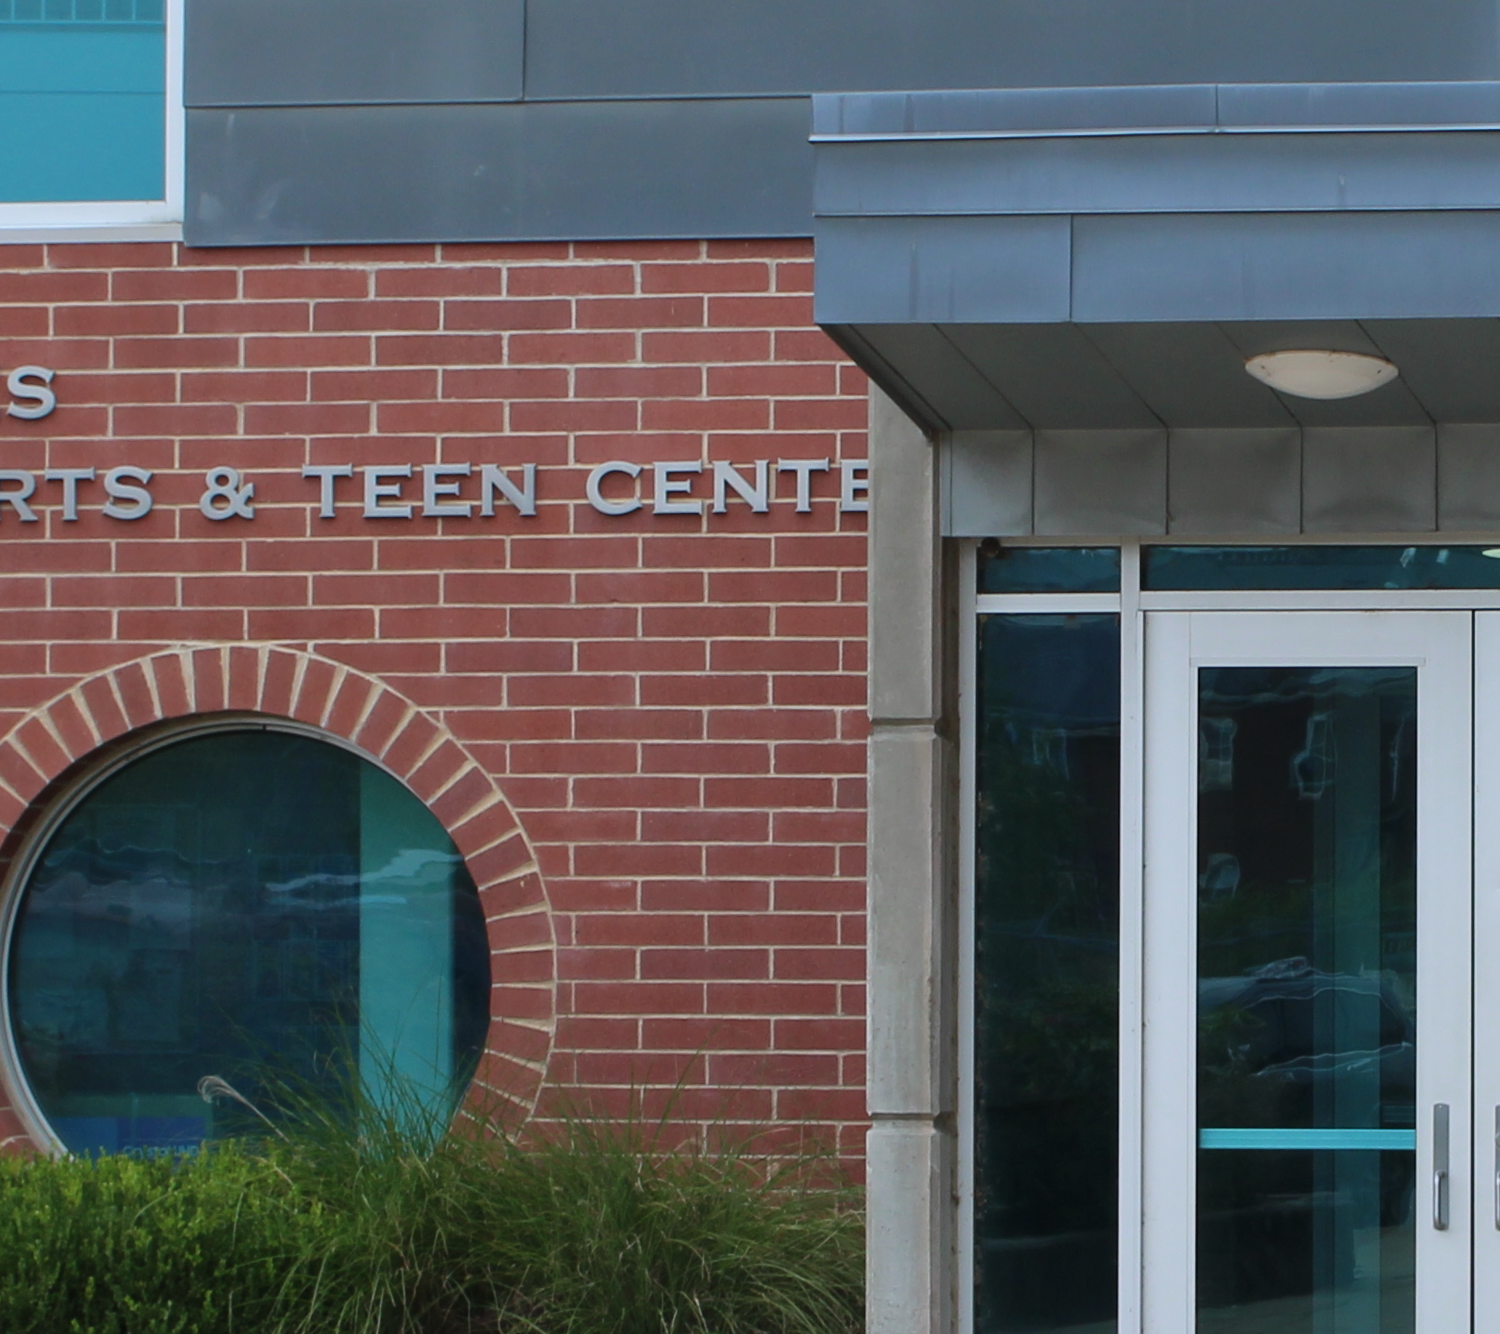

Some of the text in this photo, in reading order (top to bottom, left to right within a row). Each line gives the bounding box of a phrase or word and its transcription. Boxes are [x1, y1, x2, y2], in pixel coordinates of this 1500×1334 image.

[199, 465, 256, 522] &
[303, 462, 539, 520] TEEN
[585, 458, 869, 517] CENTE
